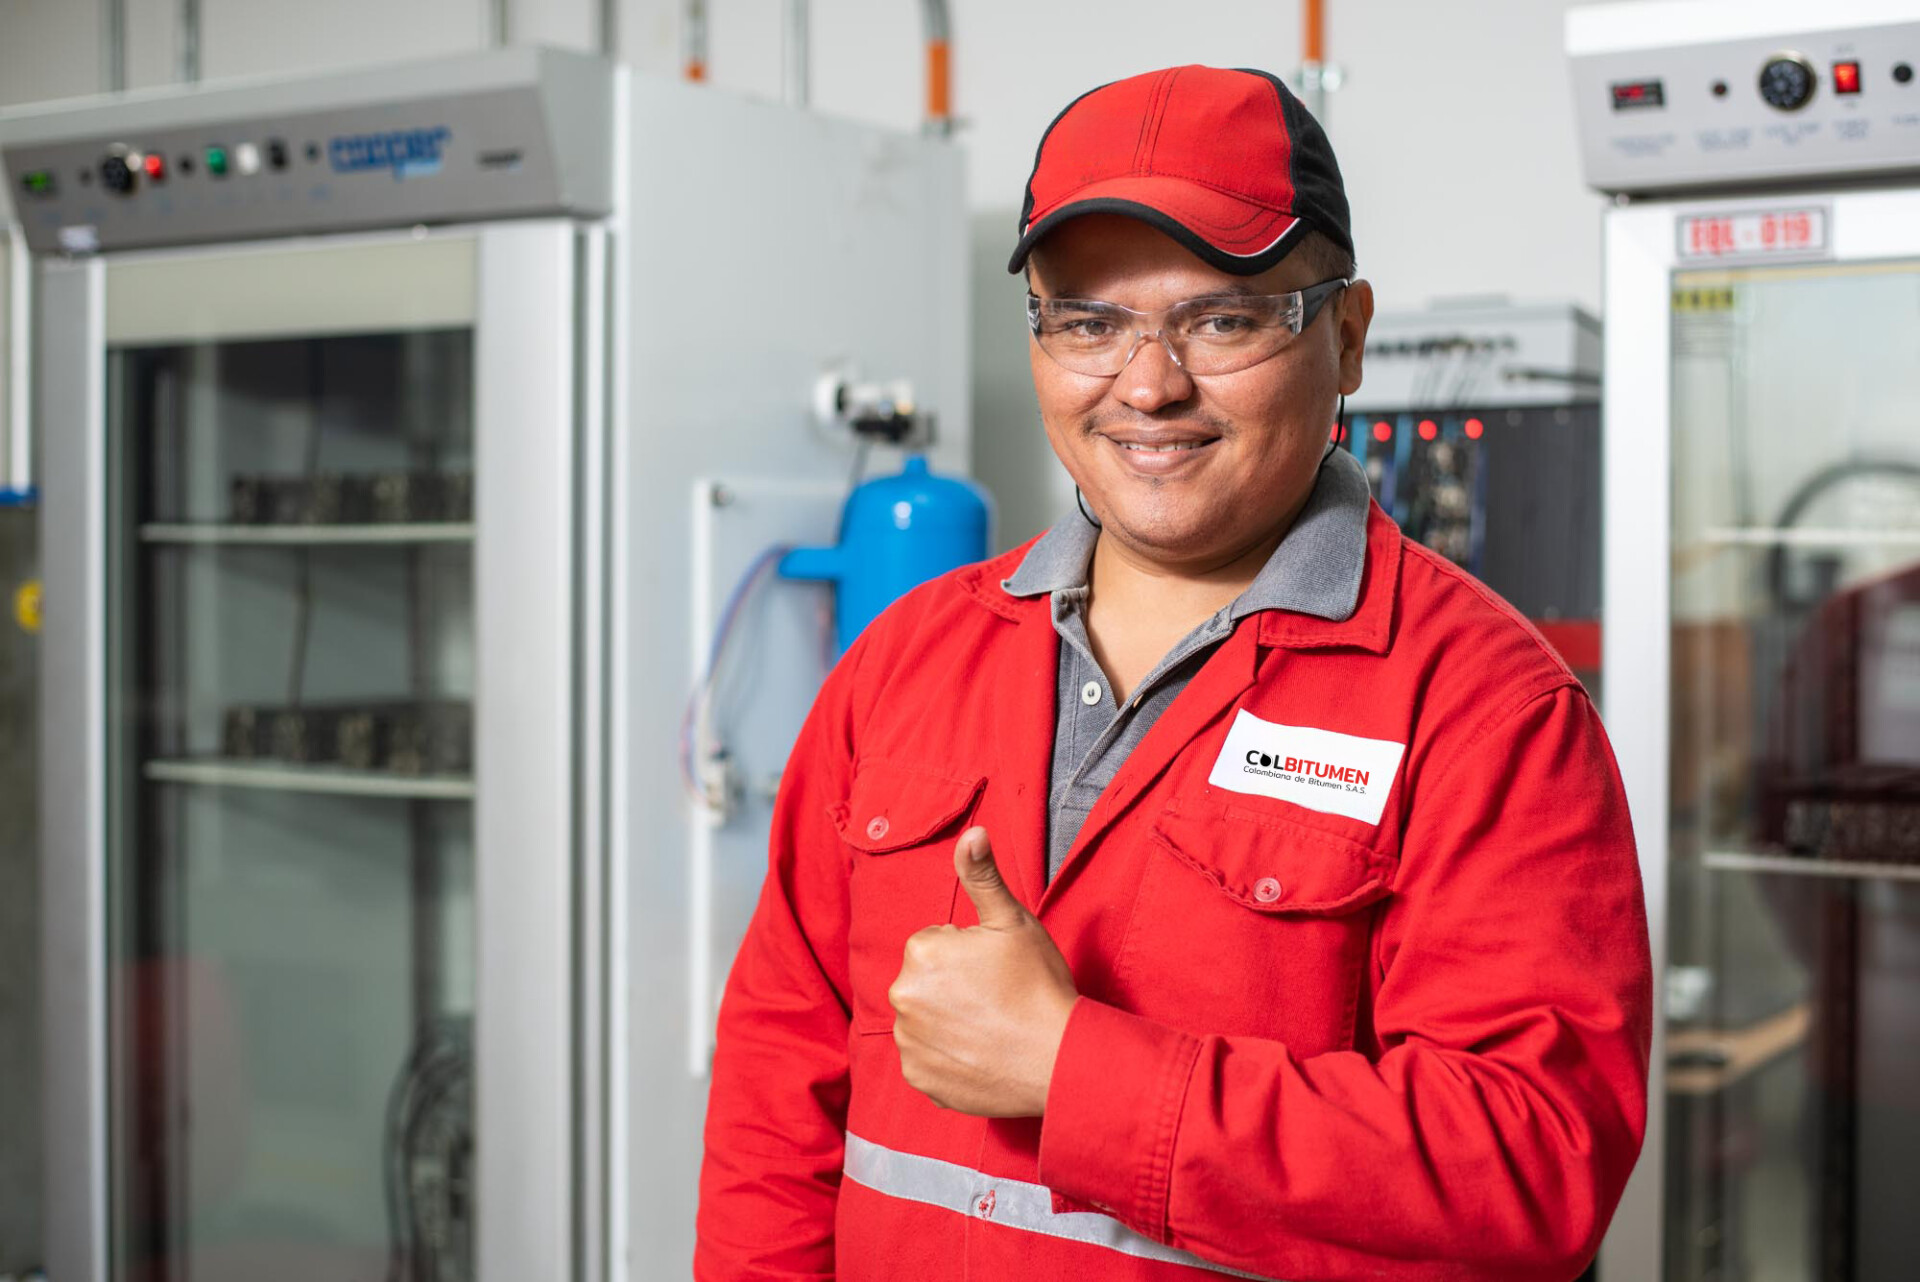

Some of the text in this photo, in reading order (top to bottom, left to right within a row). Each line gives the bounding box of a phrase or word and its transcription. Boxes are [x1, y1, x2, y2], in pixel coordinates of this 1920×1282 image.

[1243, 765, 1367, 795] Colombiana de Bitumen S.A.S.
[1246, 750, 1370, 785] COLBITUMEN
